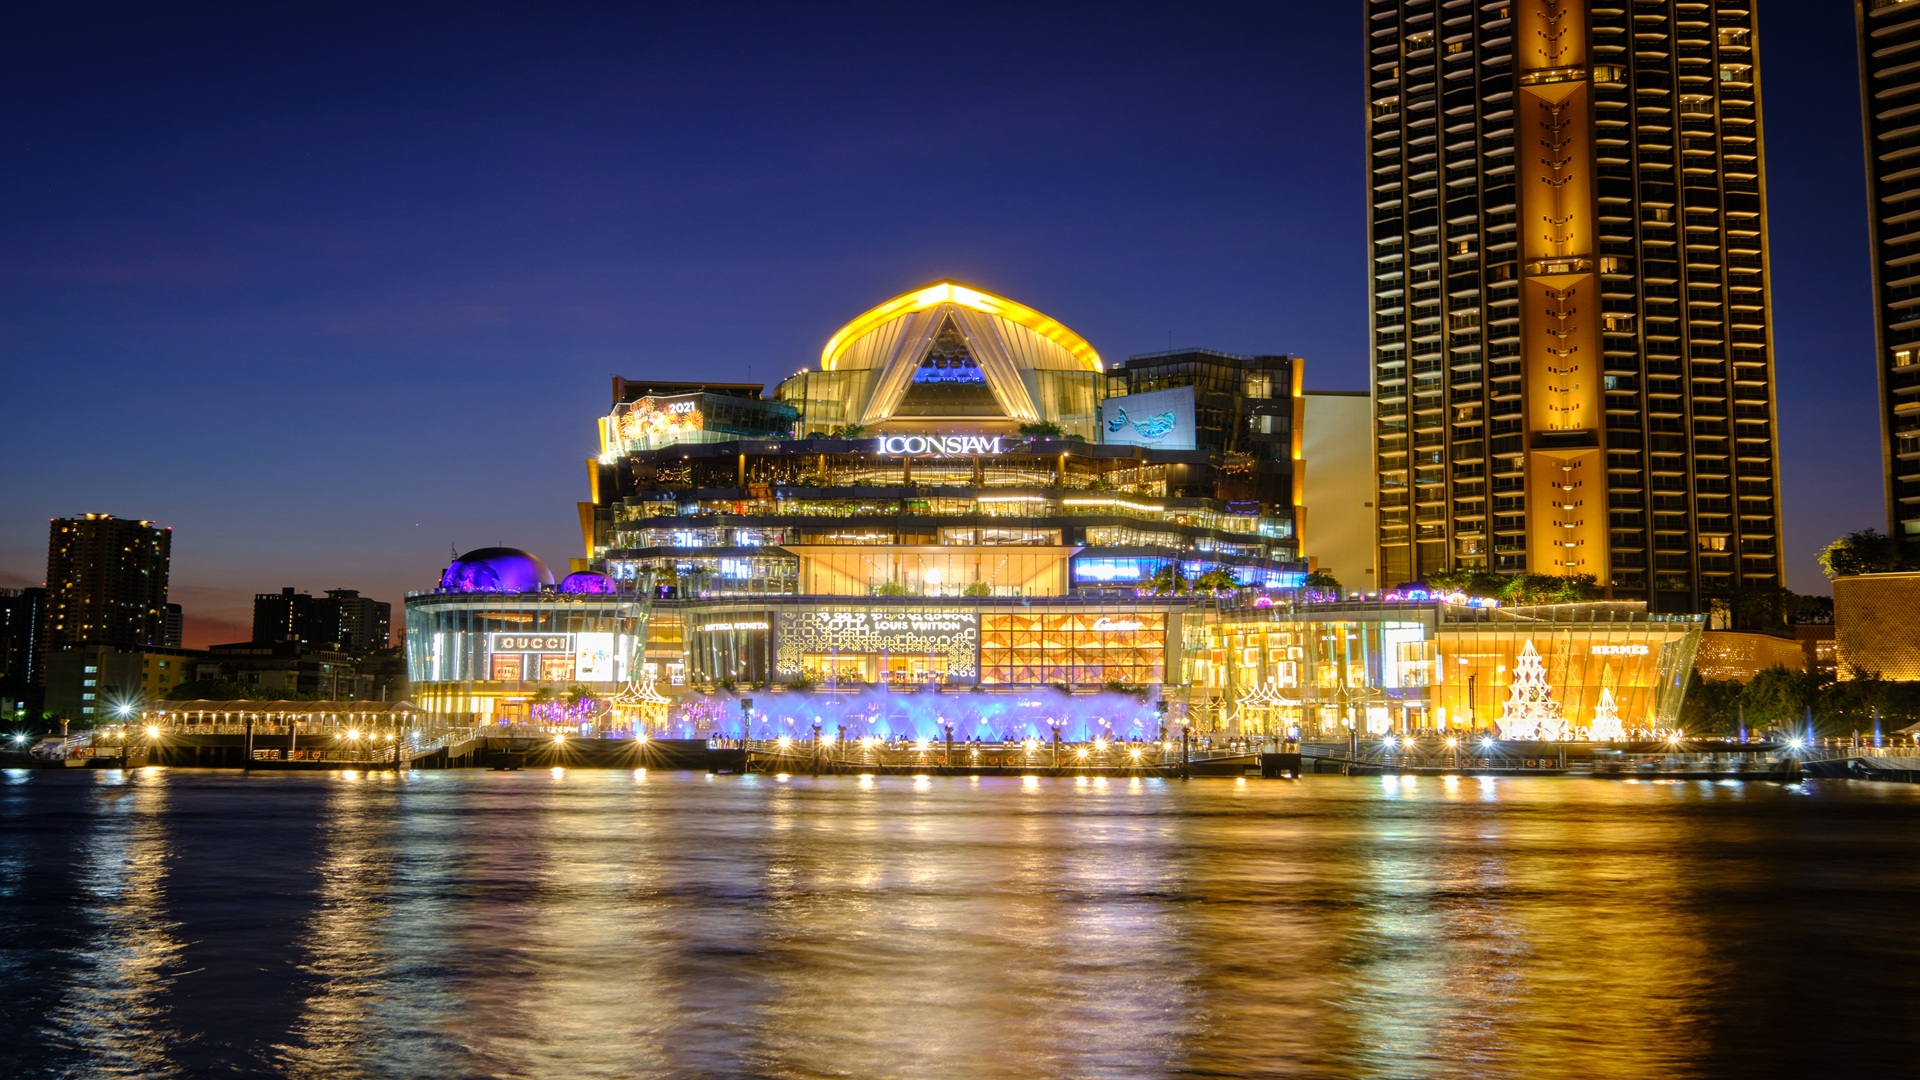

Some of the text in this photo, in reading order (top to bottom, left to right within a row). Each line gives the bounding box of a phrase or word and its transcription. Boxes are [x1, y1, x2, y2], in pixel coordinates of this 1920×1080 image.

[669, 402, 696, 413] 2021
[878, 436, 1000, 454] ICONSIAM
[875, 621, 961, 631] LOUIS VUITTON
[502, 637, 566, 649] GUCCI
